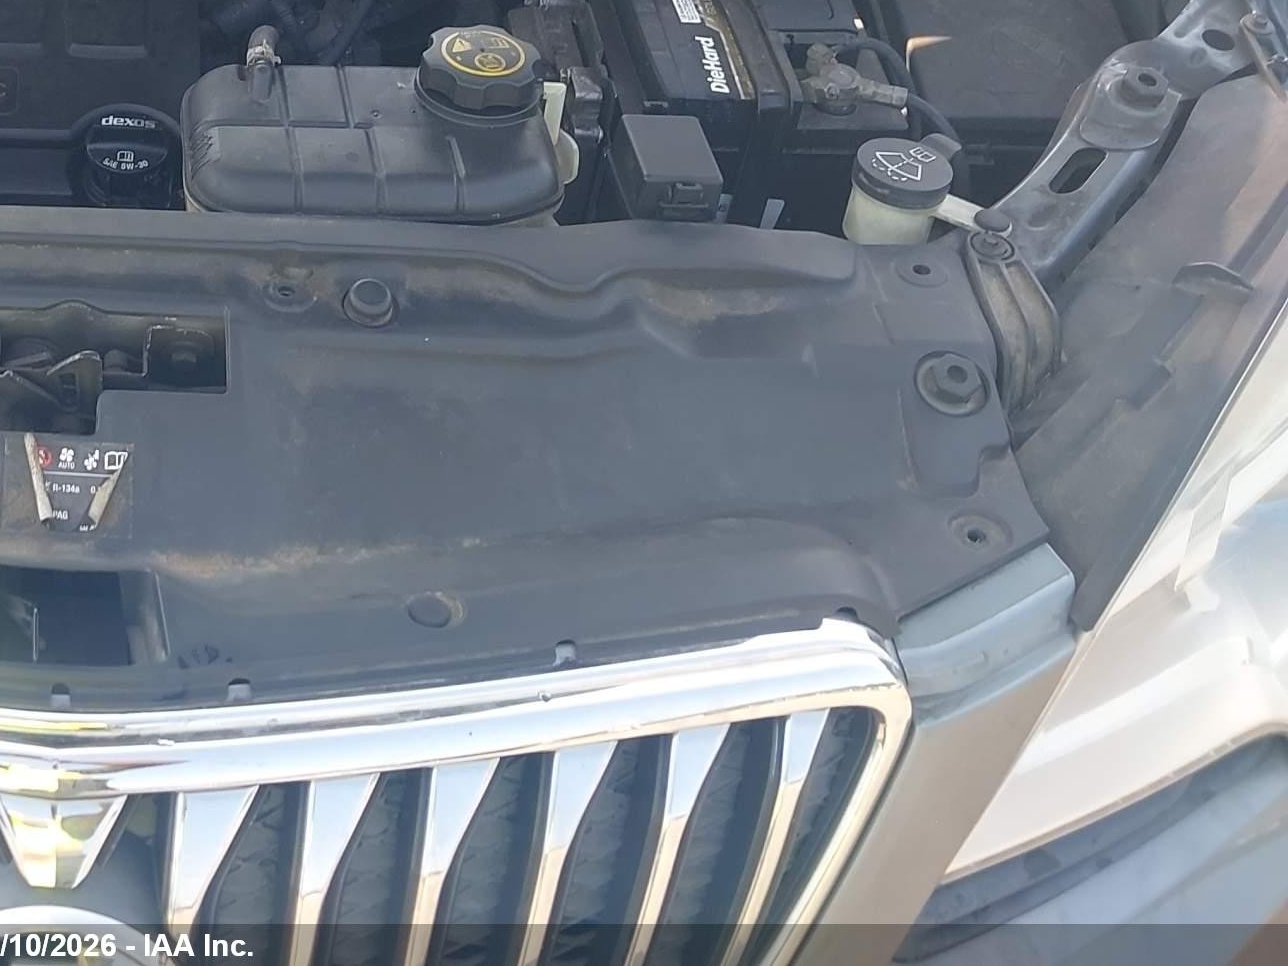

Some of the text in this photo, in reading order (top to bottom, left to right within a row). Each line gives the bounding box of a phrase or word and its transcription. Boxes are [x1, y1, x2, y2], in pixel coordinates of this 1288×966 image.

[694, 35, 730, 94] DieHard
[101, 115, 156, 129] dexos
[102, 157, 149, 171] SAE 5W-30
[58, 461, 76, 471] AUTO
